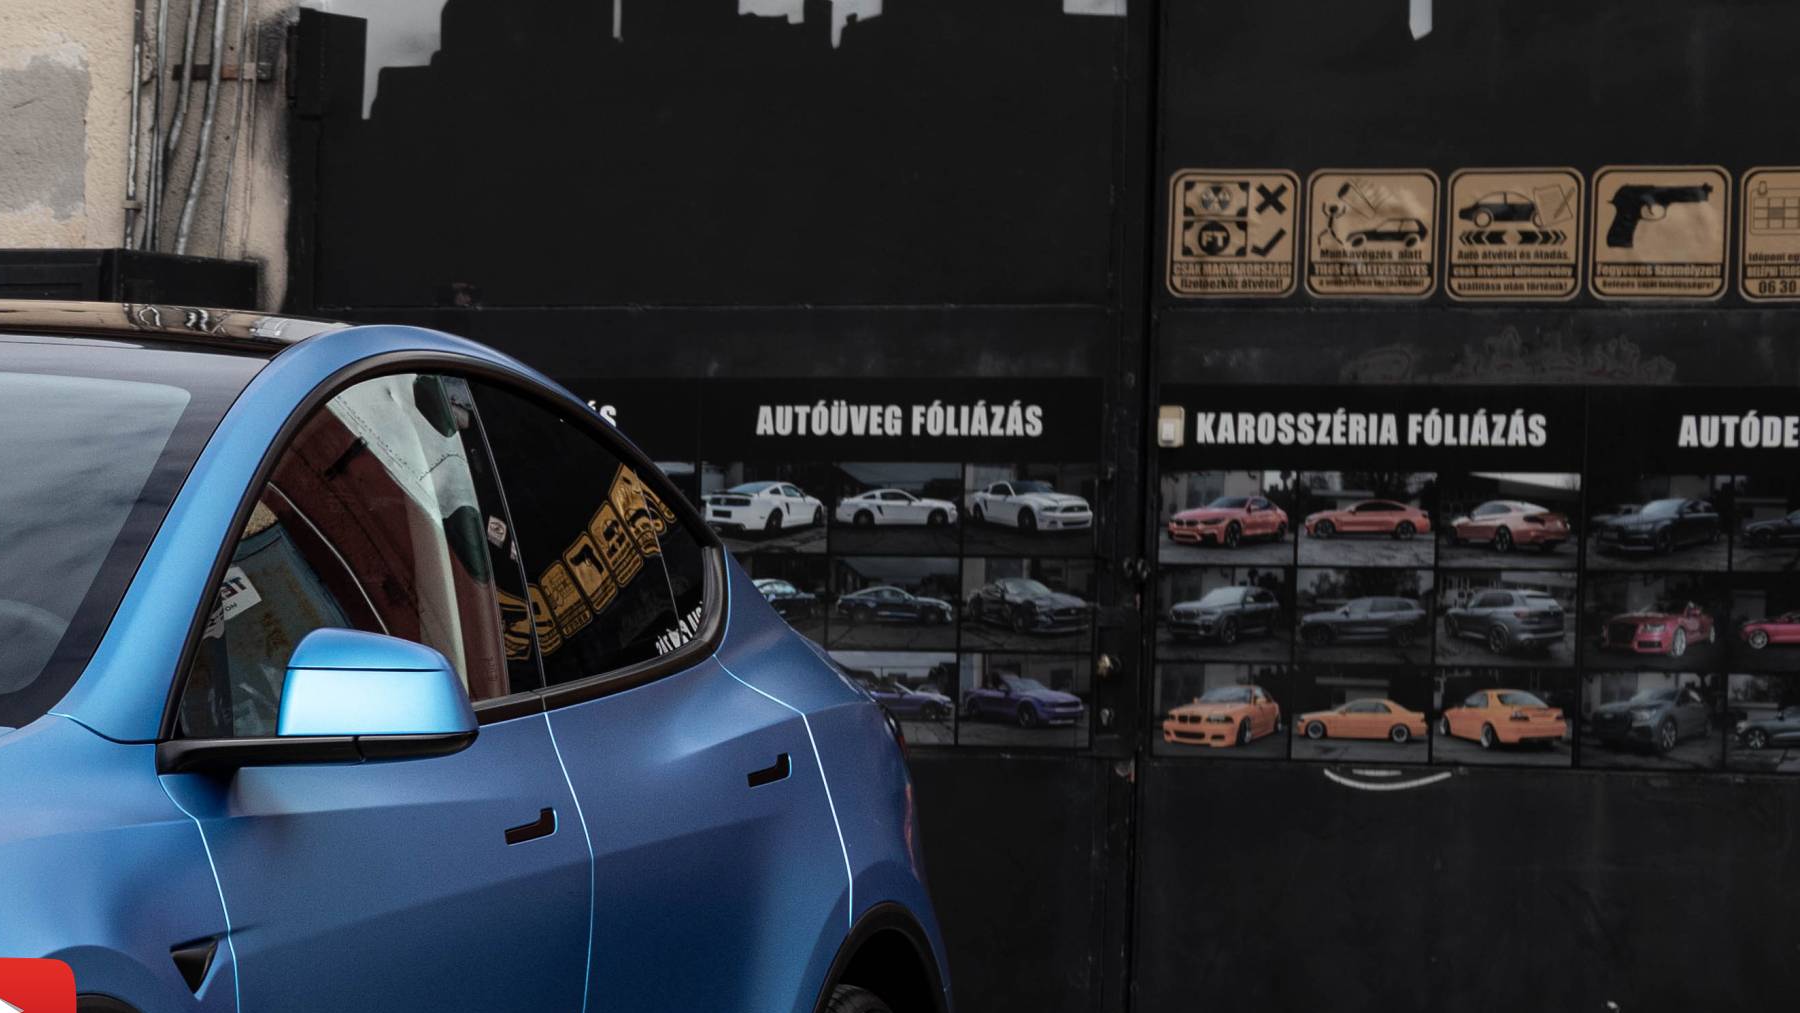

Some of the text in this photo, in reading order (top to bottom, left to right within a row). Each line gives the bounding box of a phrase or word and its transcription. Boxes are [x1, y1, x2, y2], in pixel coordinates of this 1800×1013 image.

[1202, 231, 1227, 247] FT
[1758, 279, 1797, 294] 06 30
[756, 399, 1044, 437] AUTÓÜVEG FÓLIÁZÁS
[1196, 408, 1548, 447] KAROSSZÉRIA FÓLIÁZÁS
[1677, 409, 1800, 448] AUTÓDE
